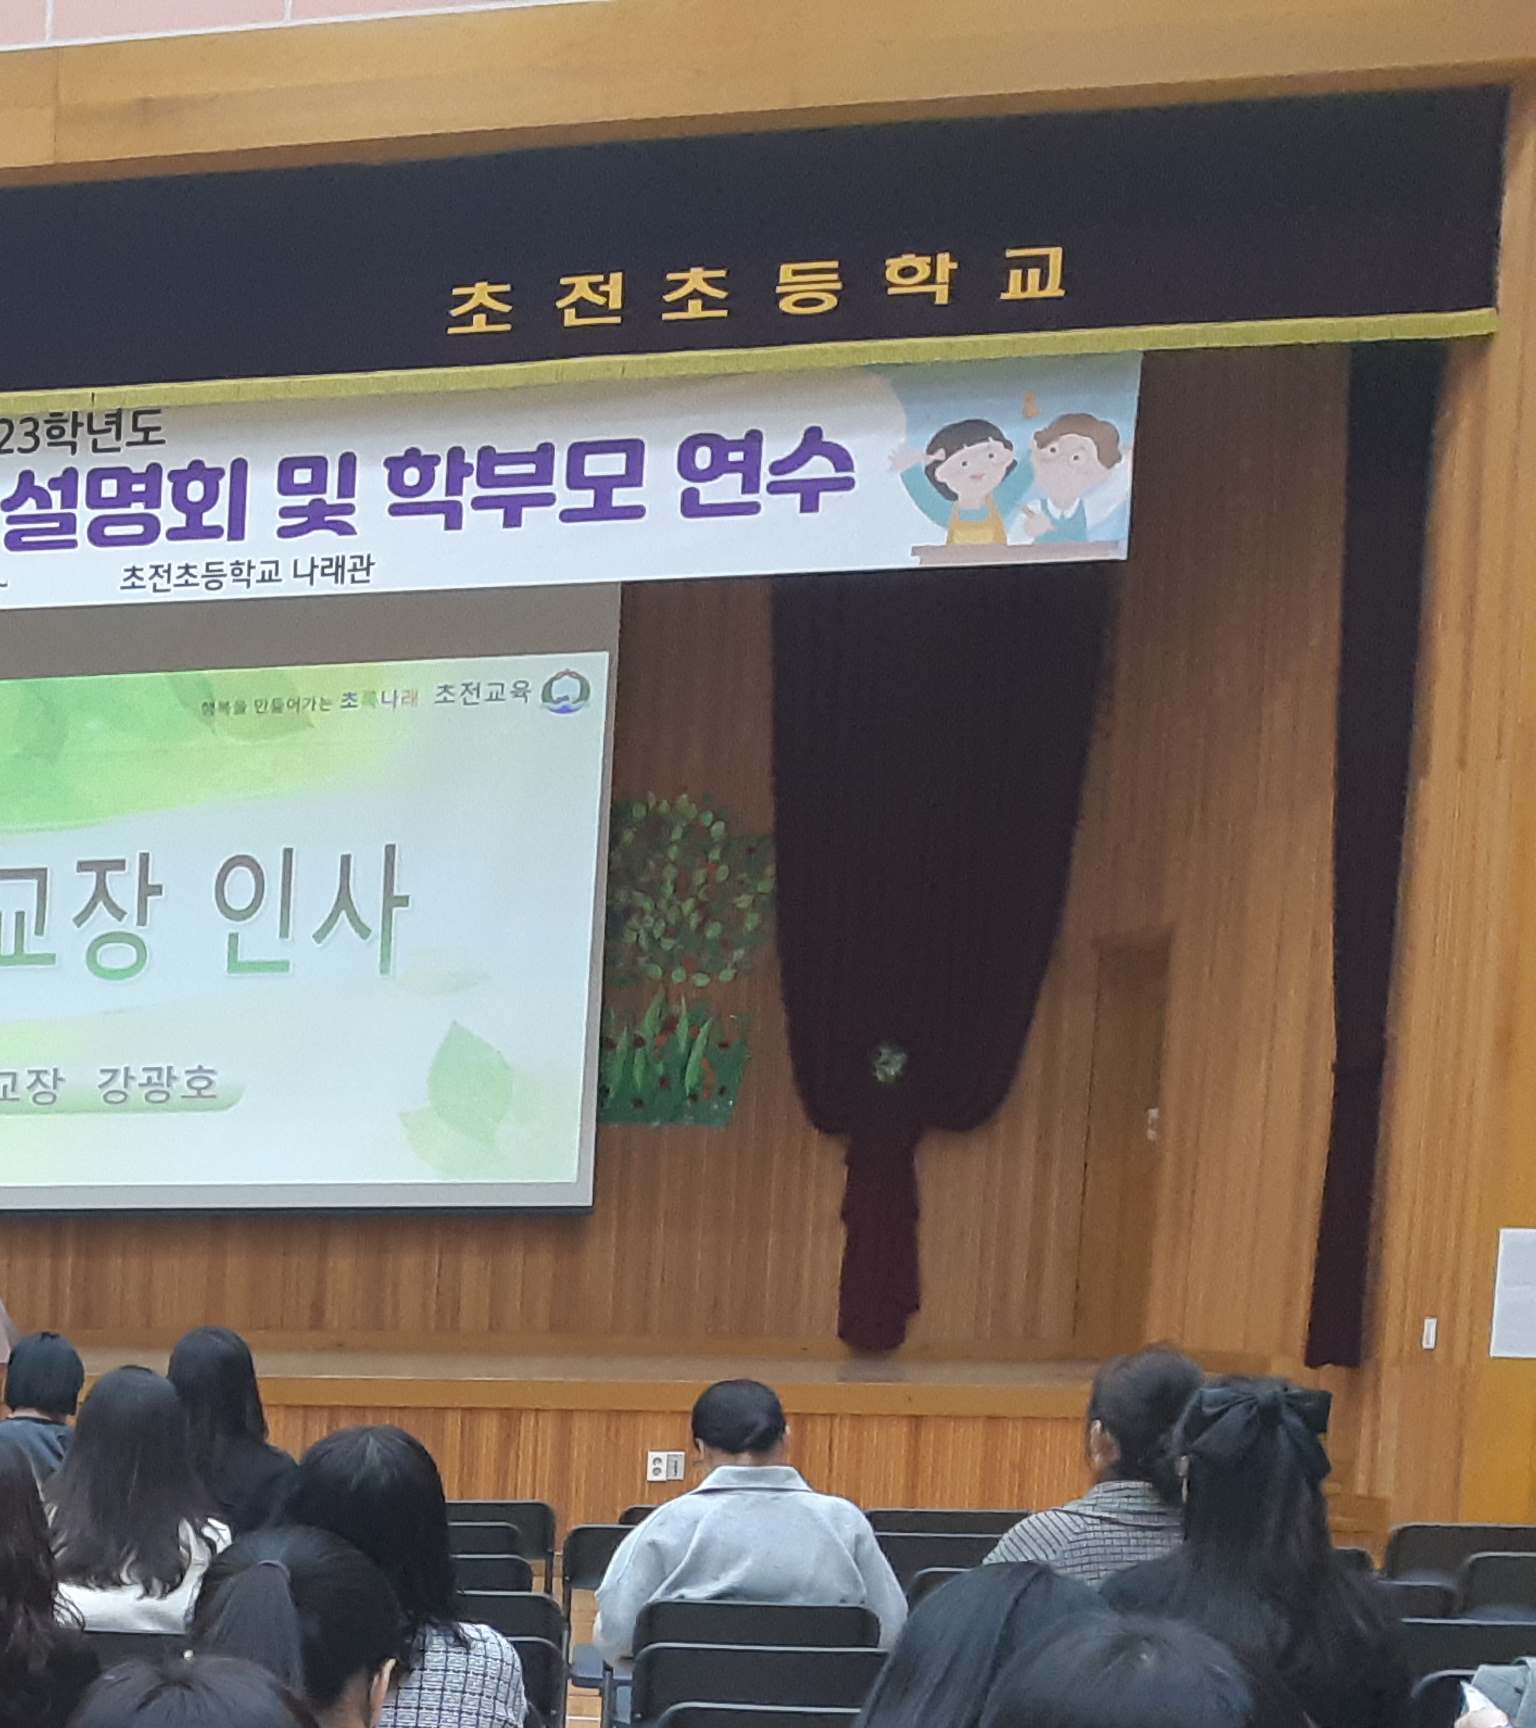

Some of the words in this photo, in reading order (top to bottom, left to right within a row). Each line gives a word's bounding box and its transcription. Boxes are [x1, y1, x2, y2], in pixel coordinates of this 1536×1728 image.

[446, 246, 1067, 337] 초전초등학교
[0, 456, 246, 554] 설명회
[276, 451, 359, 538] 및
[383, 436, 648, 533] 학부모
[676, 425, 856, 519] 연수
[120, 558, 283, 594] 초전초등학교
[291, 554, 376, 588] 나래관
[434, 679, 532, 706] 초전교육
[213, 843, 411, 976] 인사
[97, 1064, 219, 1105] 강광호
